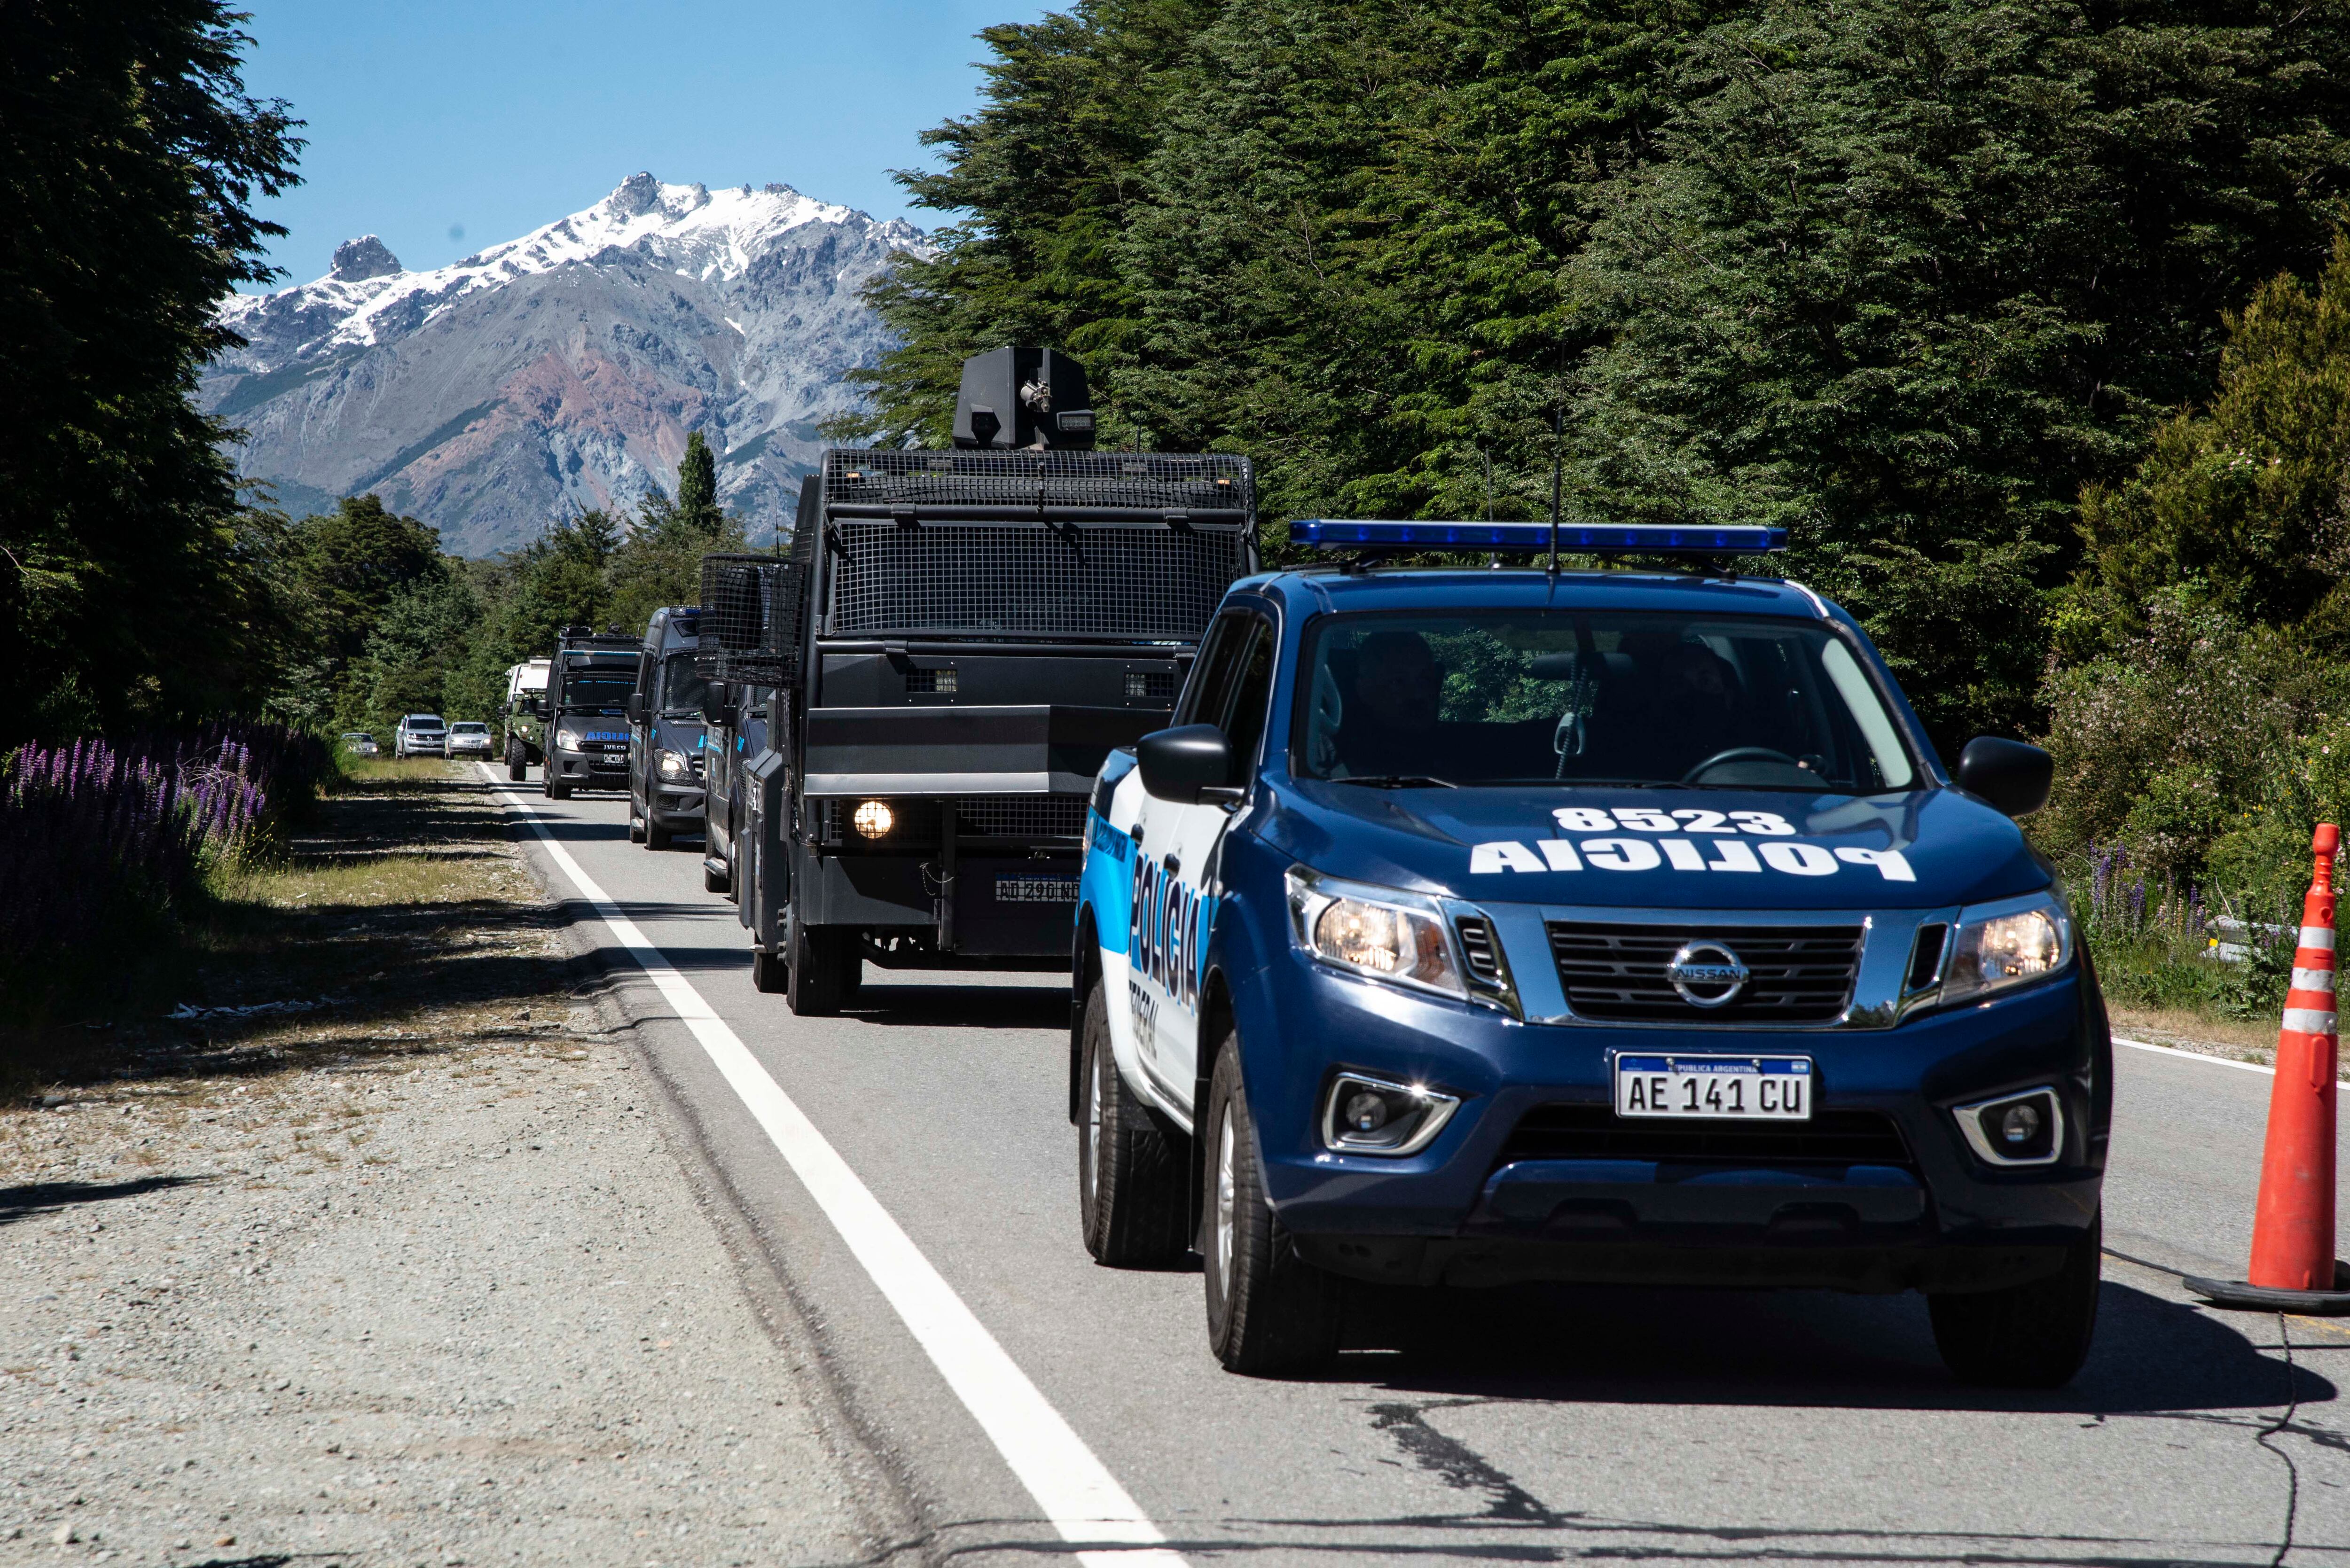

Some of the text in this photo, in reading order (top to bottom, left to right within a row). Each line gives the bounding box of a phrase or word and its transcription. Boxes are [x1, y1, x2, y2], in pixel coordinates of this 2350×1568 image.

[1552, 807, 1795, 835] 8523
[1025, 883, 1056, 900] 290
[1128, 853, 1200, 1018] POLICIA
[1675, 968, 1742, 980] NISSAN
[1668, 1064, 1758, 1074] RPUBLICA ARGENTINA
[1629, 1077, 1801, 1113] AE 141 CU
